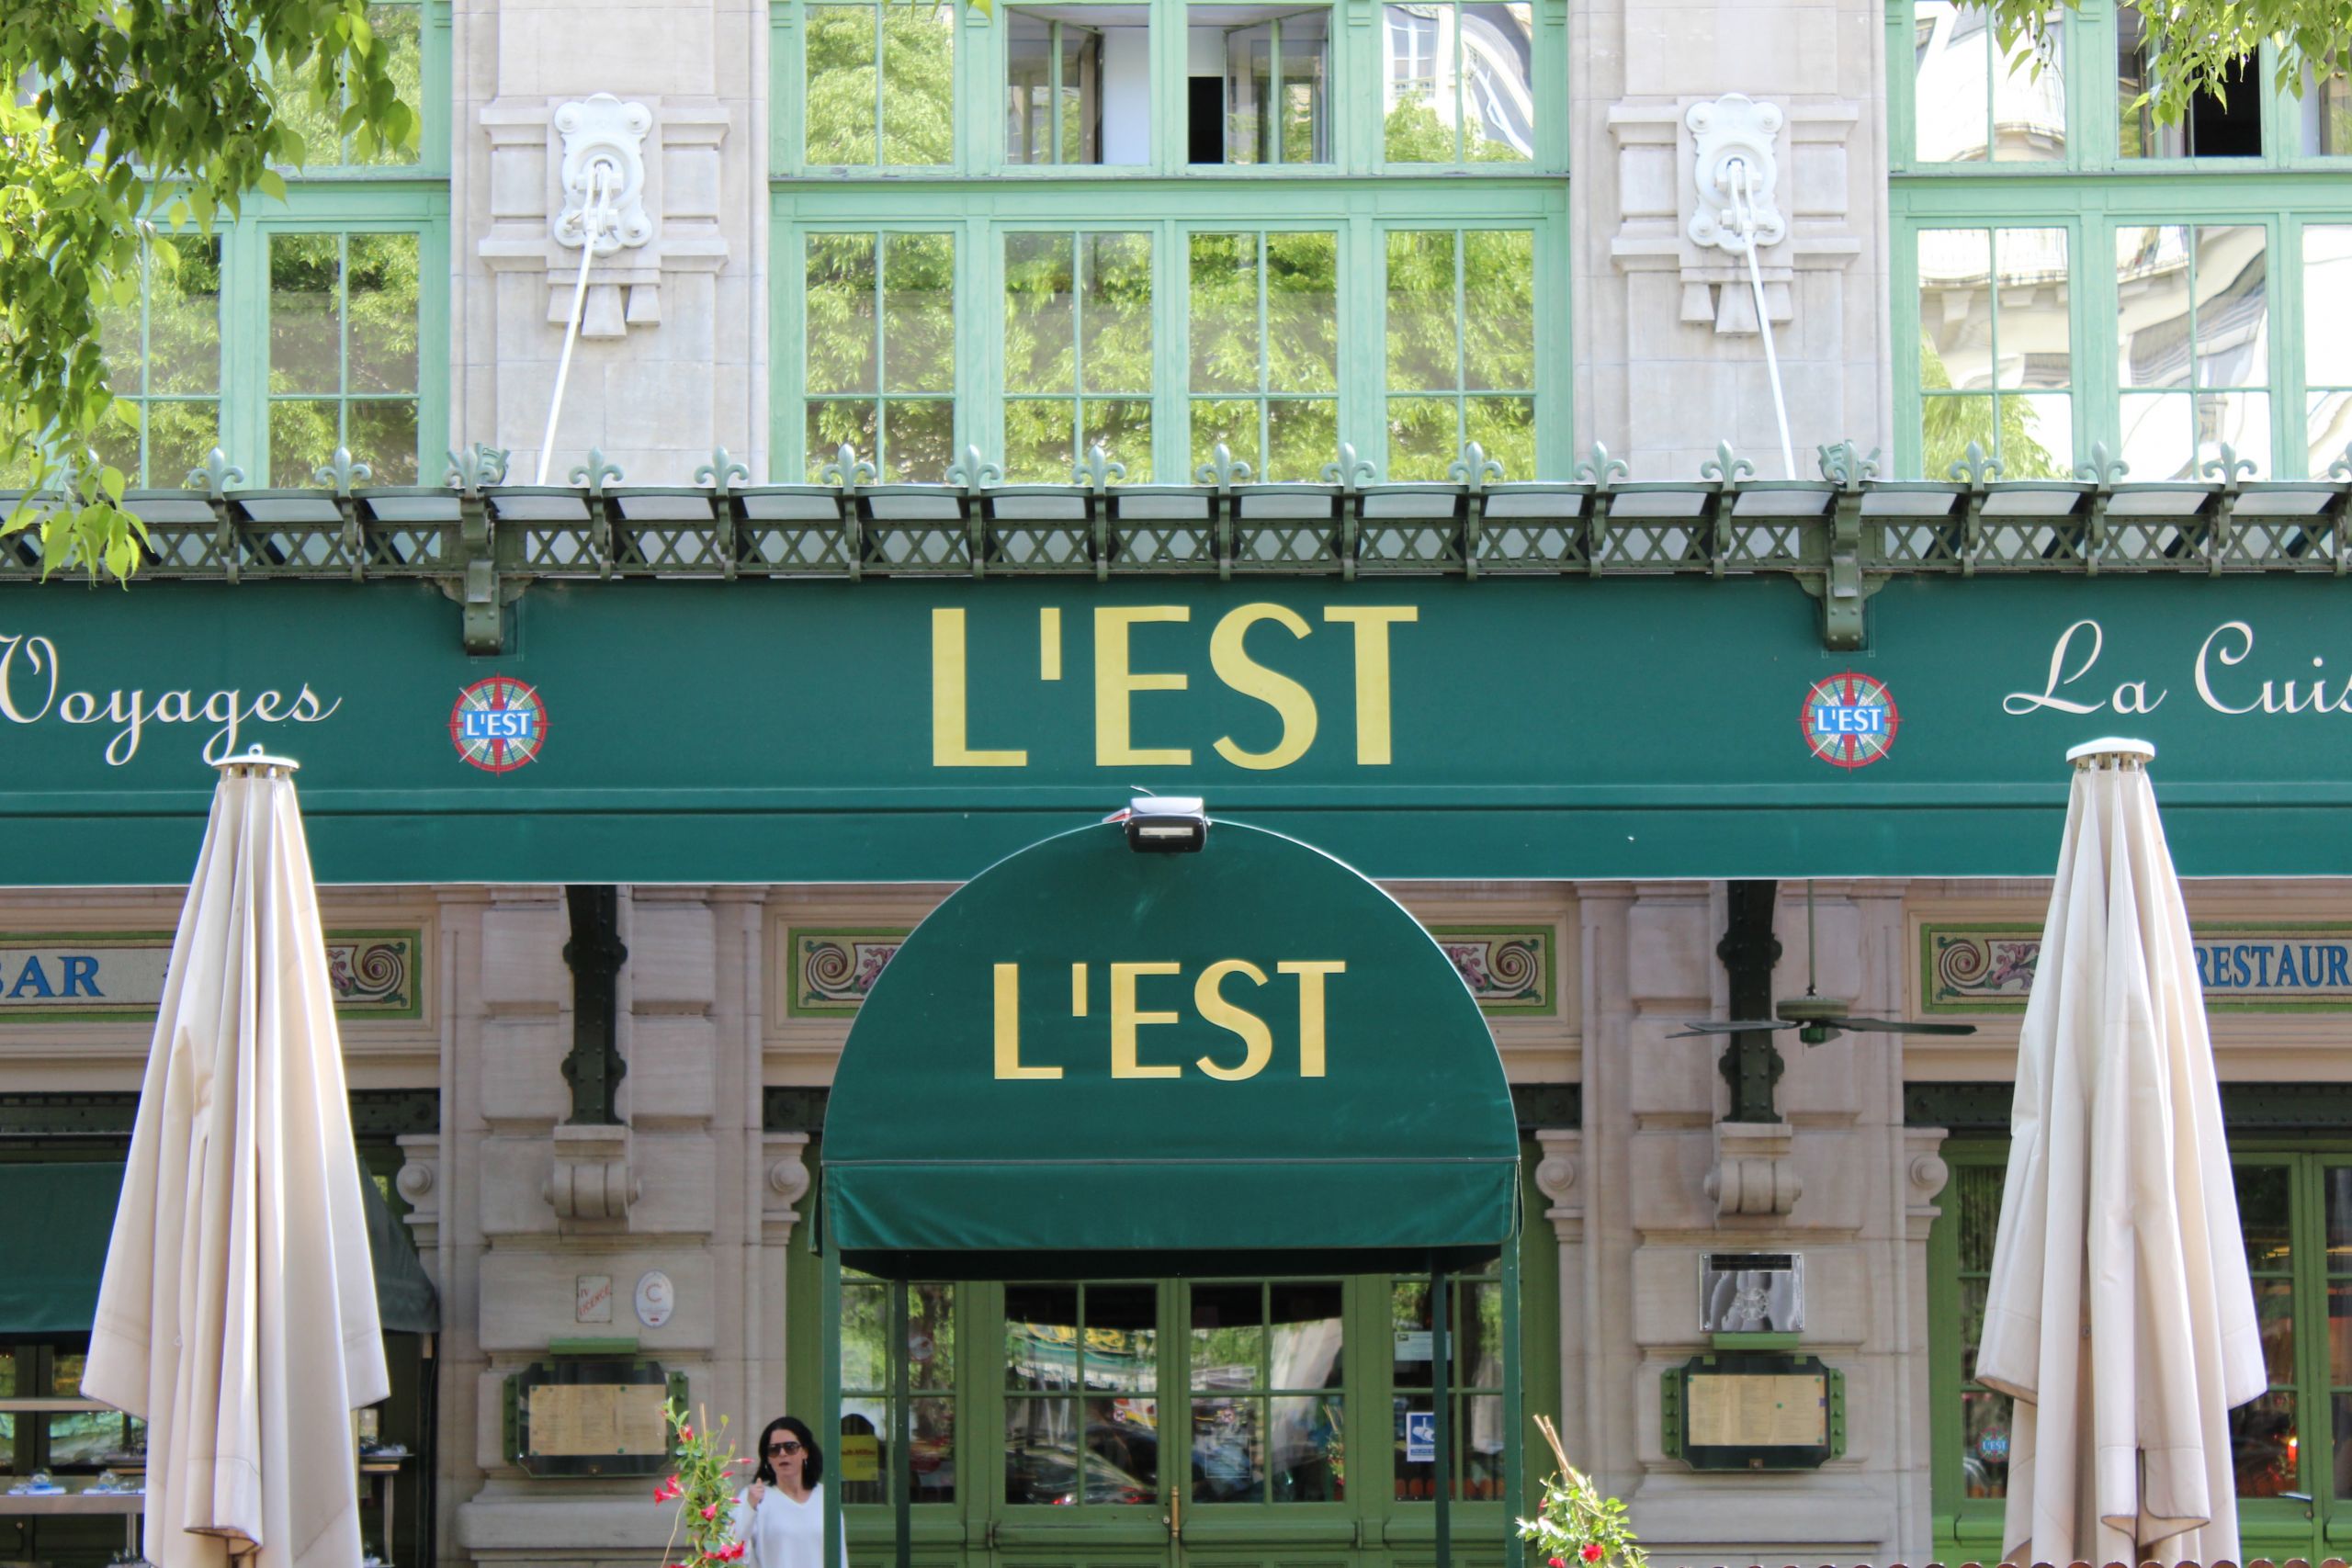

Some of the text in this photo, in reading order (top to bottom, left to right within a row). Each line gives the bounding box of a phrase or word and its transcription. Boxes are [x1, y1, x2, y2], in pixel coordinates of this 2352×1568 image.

[932, 603, 1419, 771] L'EST
[2003, 619, 2167, 716] La
[0, 634, 343, 766] Voyages
[1817, 708, 1883, 732] L'EST
[466, 712, 531, 737] L'EST
[0, 954, 106, 999] AR
[2193, 944, 2352, 988] RESTAUR
[993, 960, 1346, 1081] L'EST
[1983, 1440, 2006, 1450] L'EST
